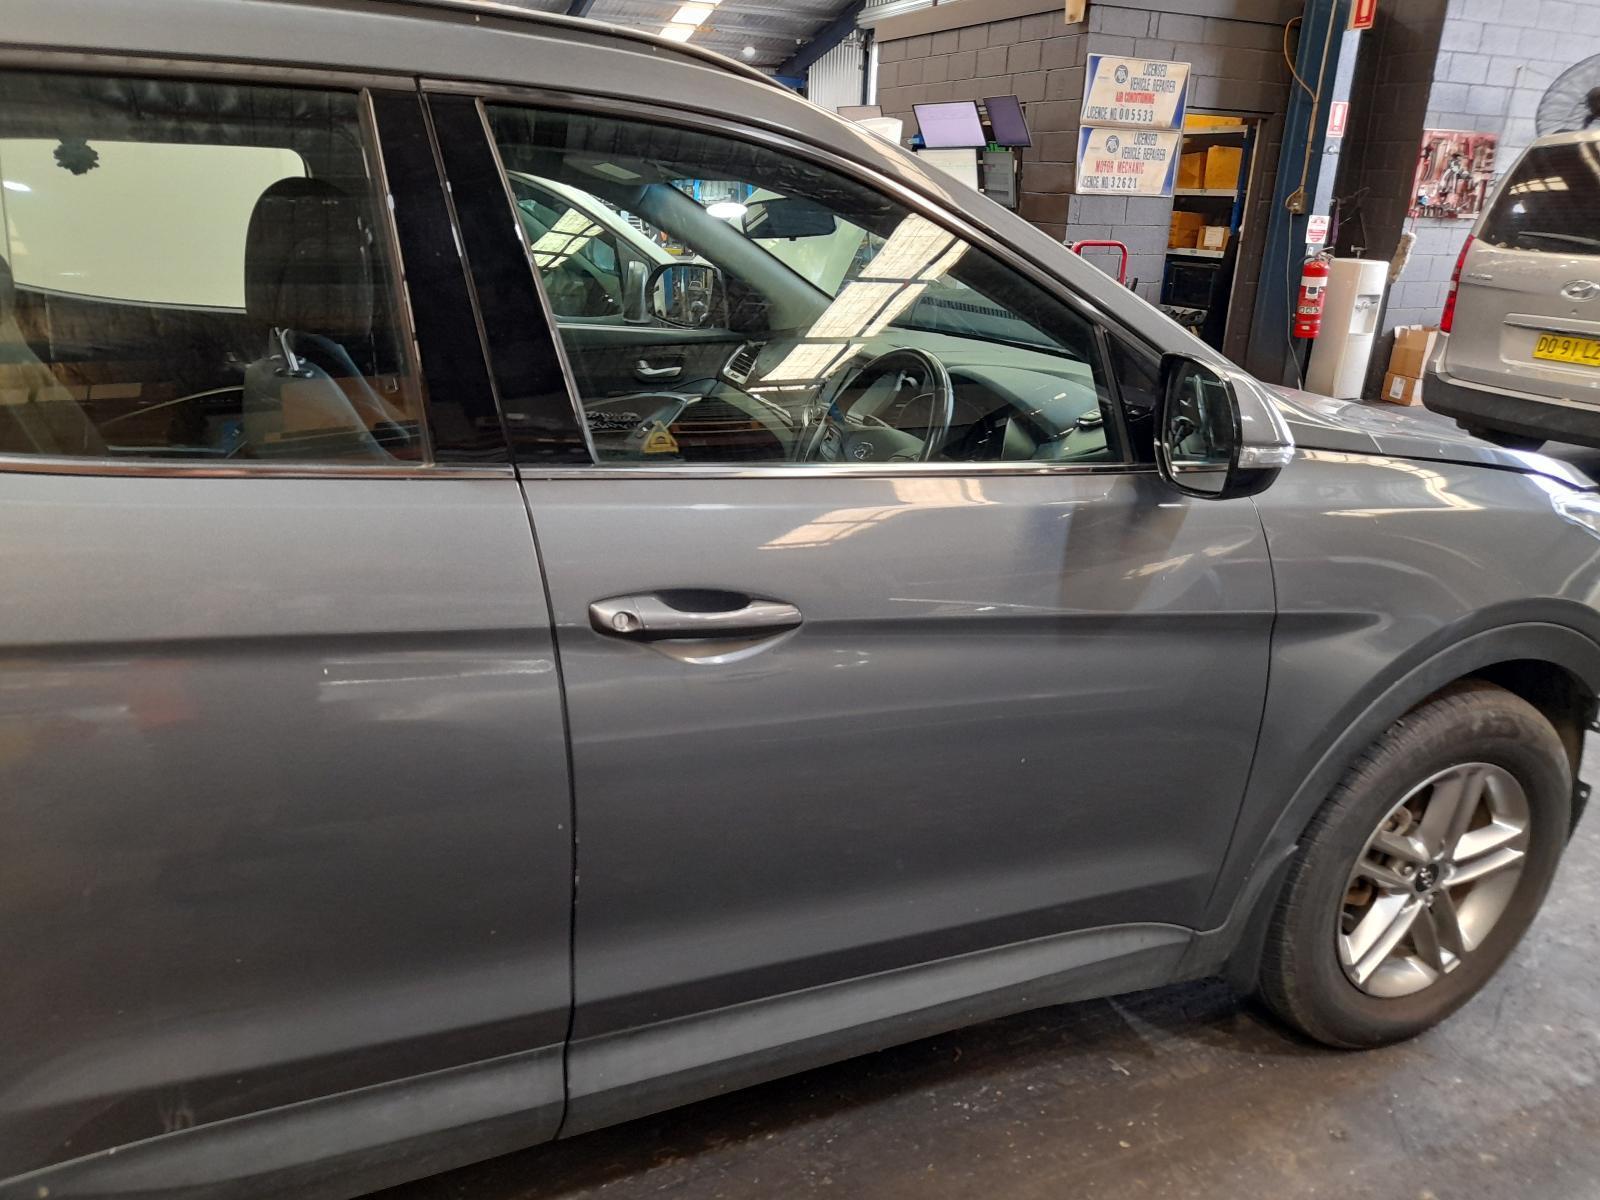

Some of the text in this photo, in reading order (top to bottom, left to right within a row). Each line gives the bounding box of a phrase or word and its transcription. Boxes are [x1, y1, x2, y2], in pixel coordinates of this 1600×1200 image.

[1143, 63, 1167, 77] LICENSED
[1130, 77, 1176, 93] VEHICLE REPAIRER
[1124, 92, 1155, 105] CONDITIONING
[1087, 106, 1107, 120] LICENCE
[1119, 109, 1153, 122] 005533
[1134, 132, 1158, 146] LICENSED
[1122, 147, 1167, 161] VEHICLE REPAIRER
[1095, 160, 1145, 175] MOTOR MECHANIC
[1111, 176, 1137, 189] 32621
